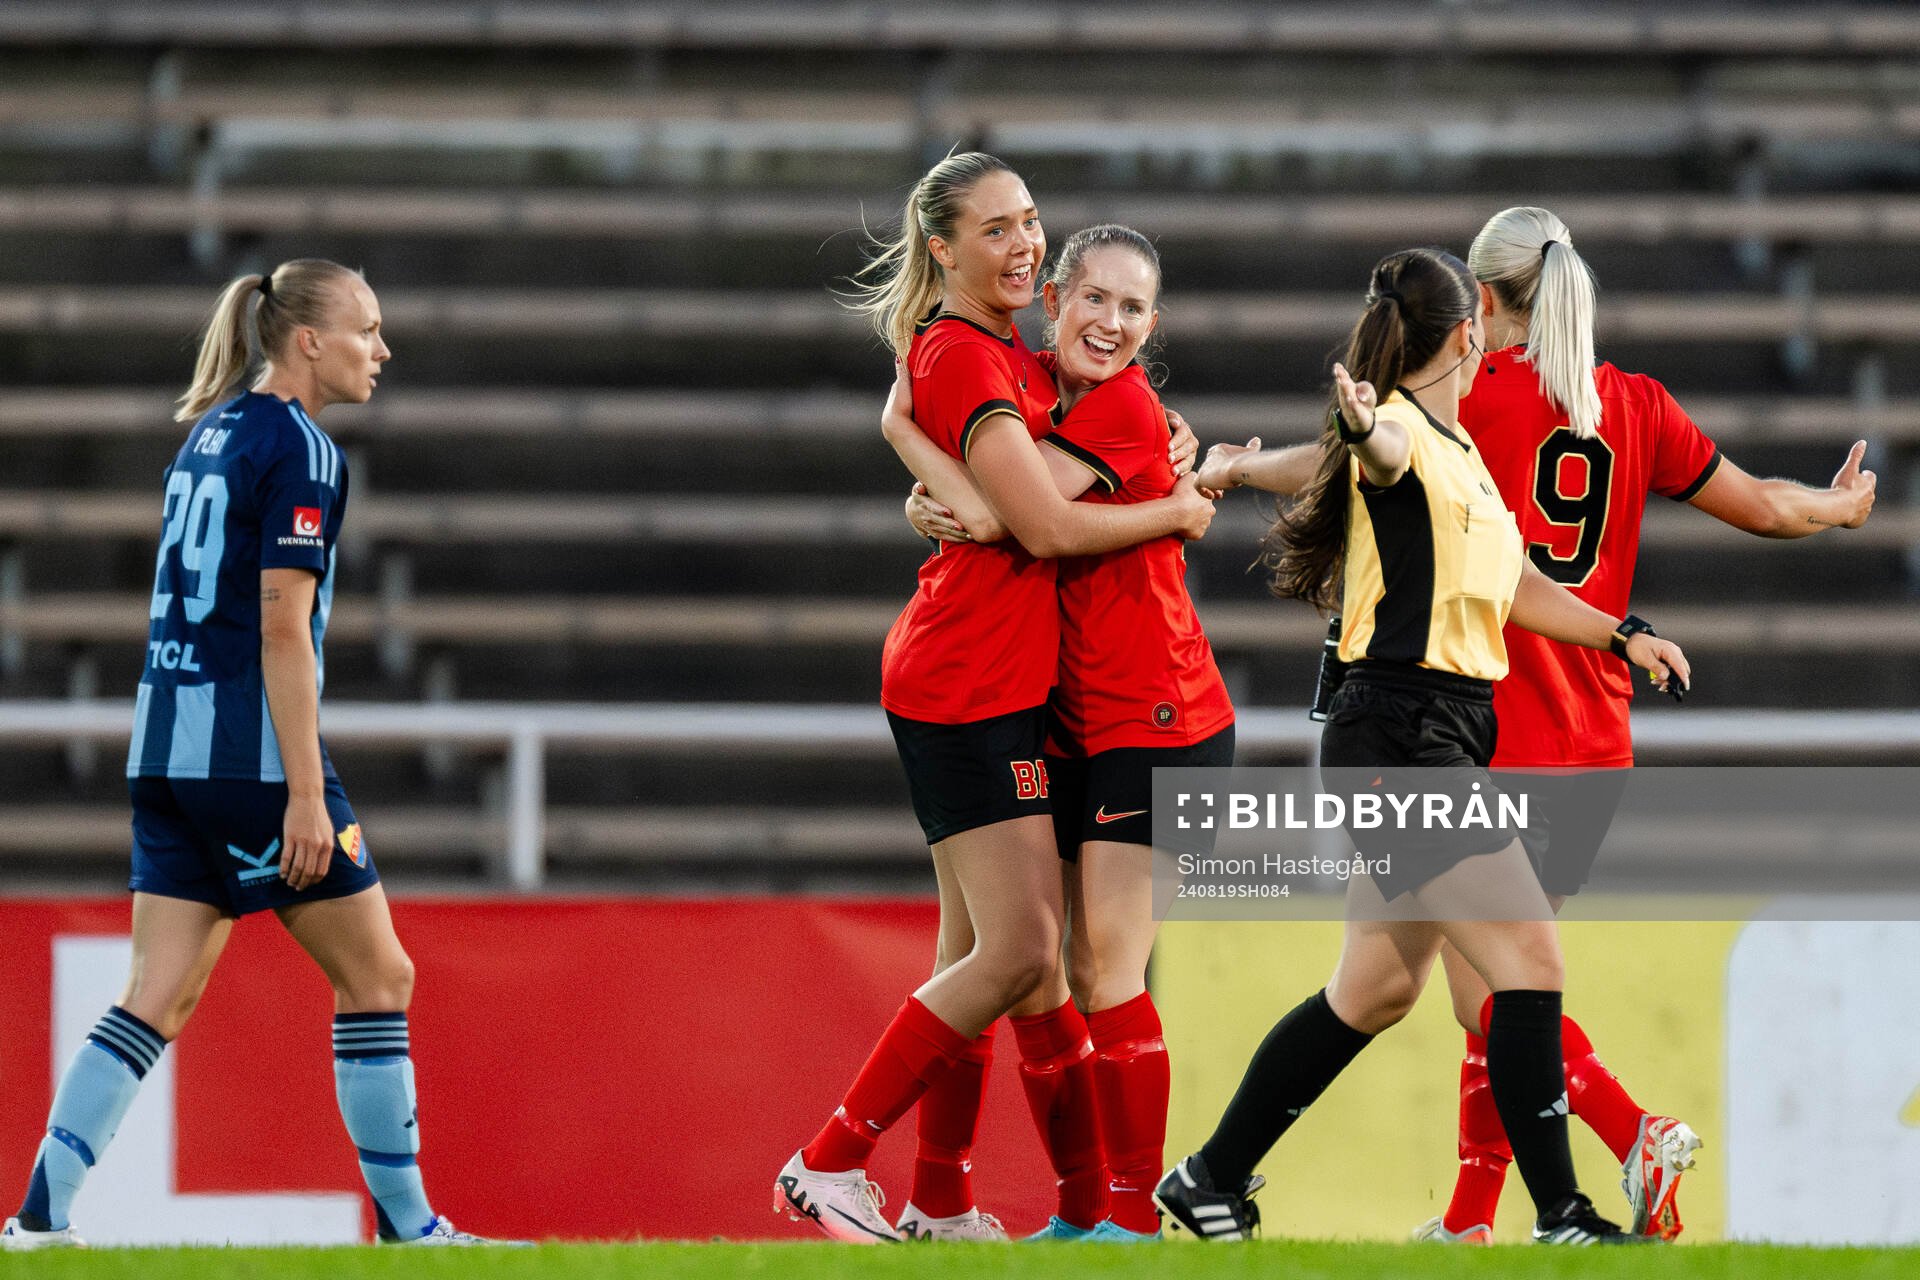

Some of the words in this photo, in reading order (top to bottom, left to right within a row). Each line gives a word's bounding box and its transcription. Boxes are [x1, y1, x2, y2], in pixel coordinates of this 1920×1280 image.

[150, 471, 229, 623] 29
[277, 537, 314, 546] SVENSKA
[1527, 426, 1614, 587] 9
[150, 640, 200, 672] TCL
